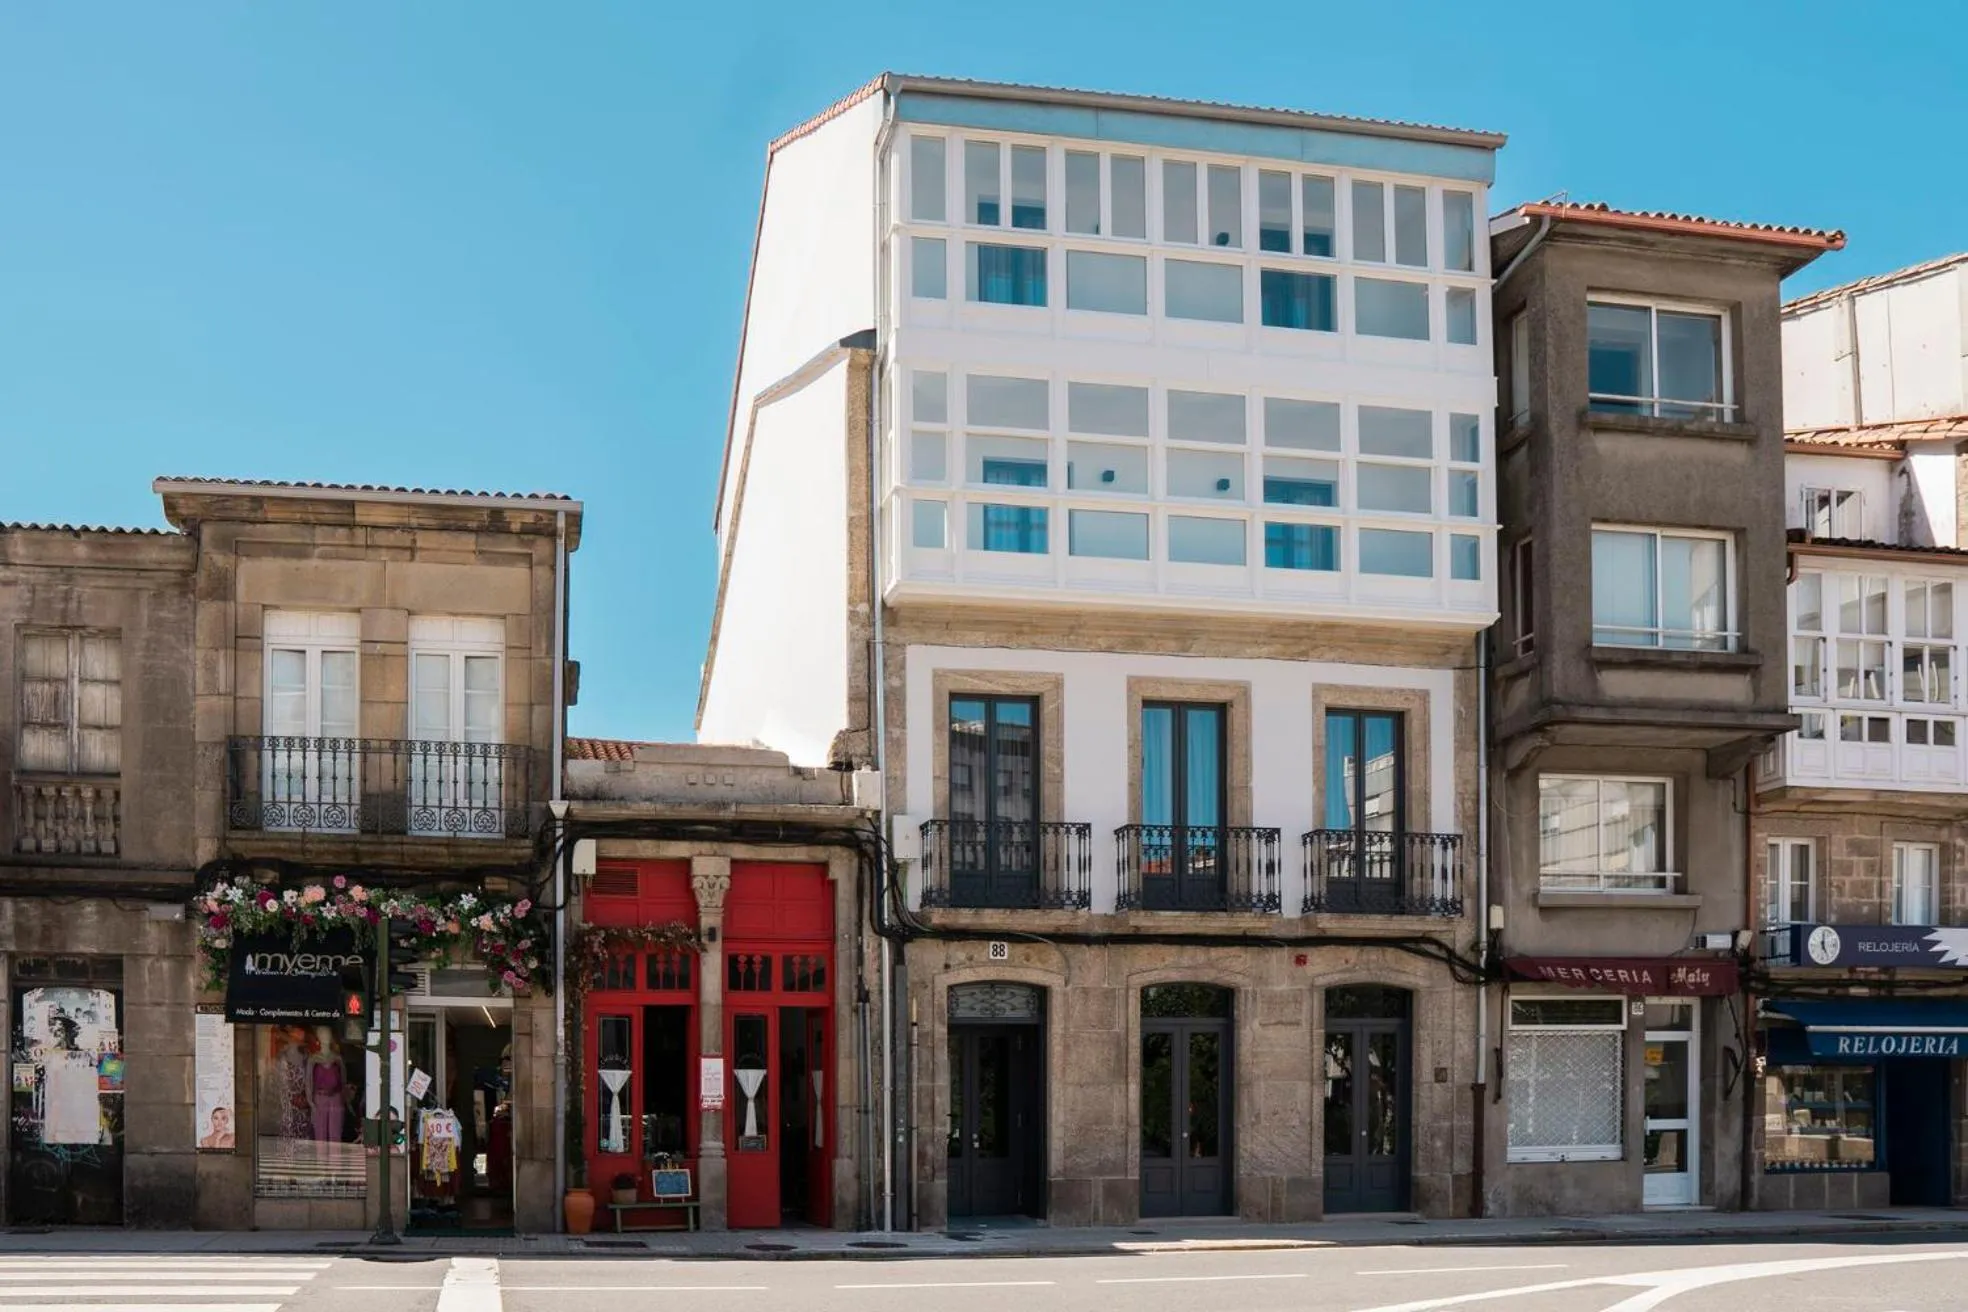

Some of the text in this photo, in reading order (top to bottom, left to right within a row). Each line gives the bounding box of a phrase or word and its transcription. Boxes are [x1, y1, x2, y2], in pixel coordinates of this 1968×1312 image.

[991, 943, 1006, 957] 88
[254, 952, 364, 976] myeme
[1538, 965, 1653, 984] MERCERIA
[1837, 1035, 1960, 1055] RELOJERIA
